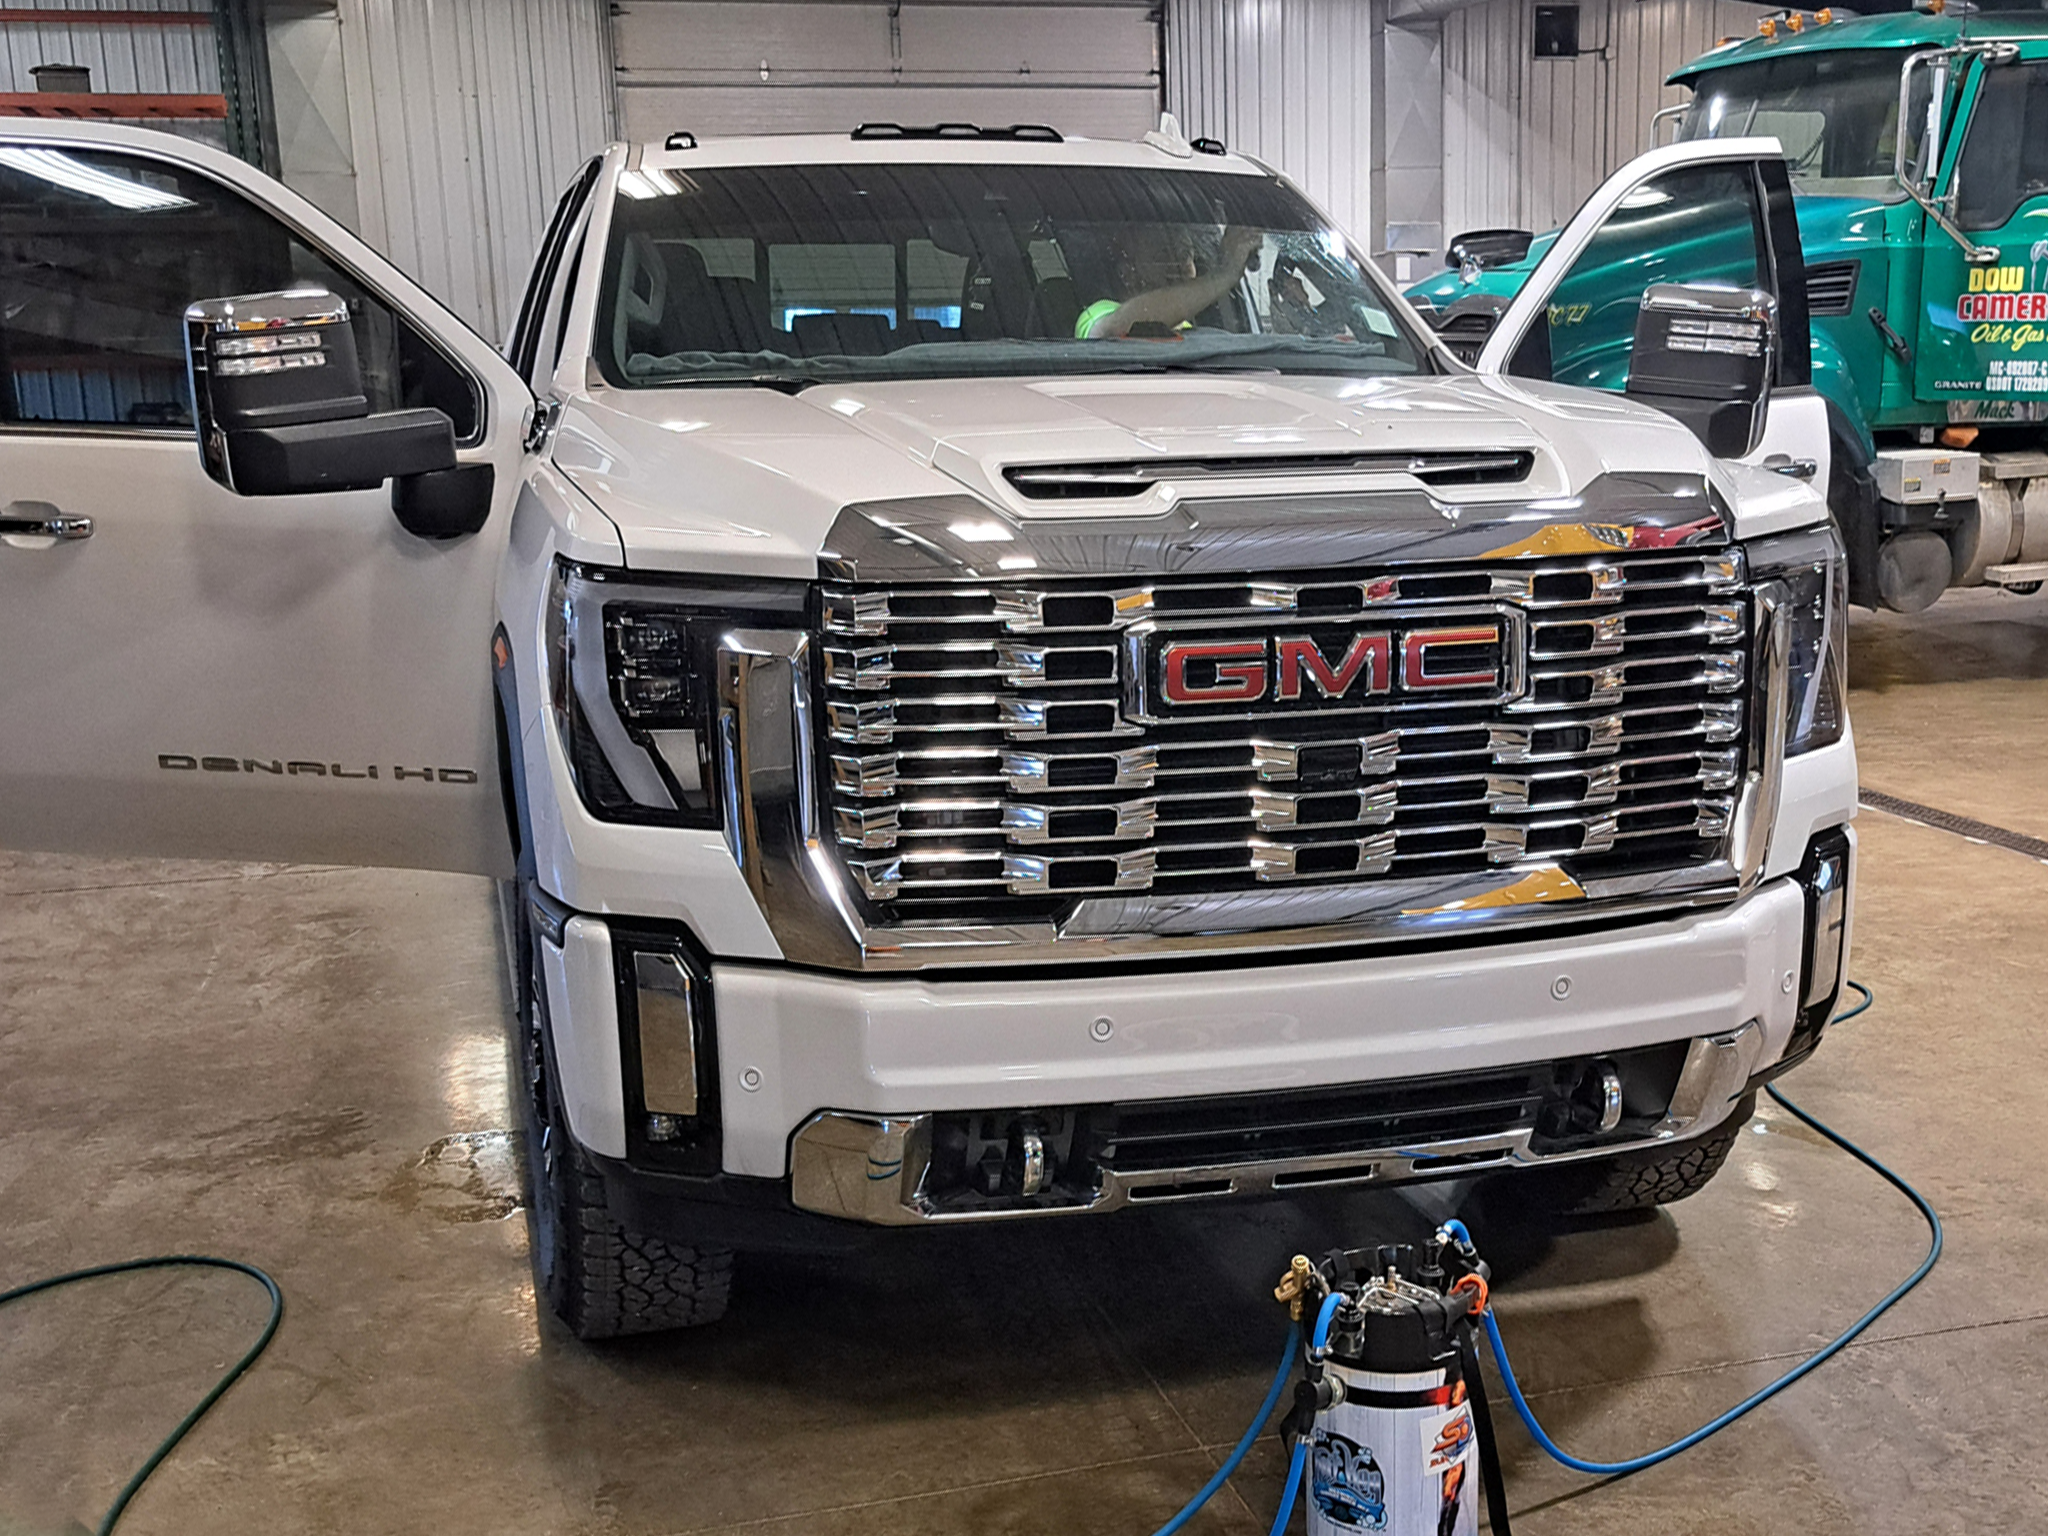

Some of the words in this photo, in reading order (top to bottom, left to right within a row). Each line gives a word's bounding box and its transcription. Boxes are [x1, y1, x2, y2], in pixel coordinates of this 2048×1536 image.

[1968, 265, 2025, 292] DOW
[1971, 323, 2004, 343] Oil
[2010, 323, 2045, 352] Gas
[1934, 380, 1982, 390] GRANITE
[1974, 400, 2015, 419] Mack
[1160, 626, 1500, 706] GMC
[158, 754, 379, 780] DENALI
[394, 765, 478, 784] HD
